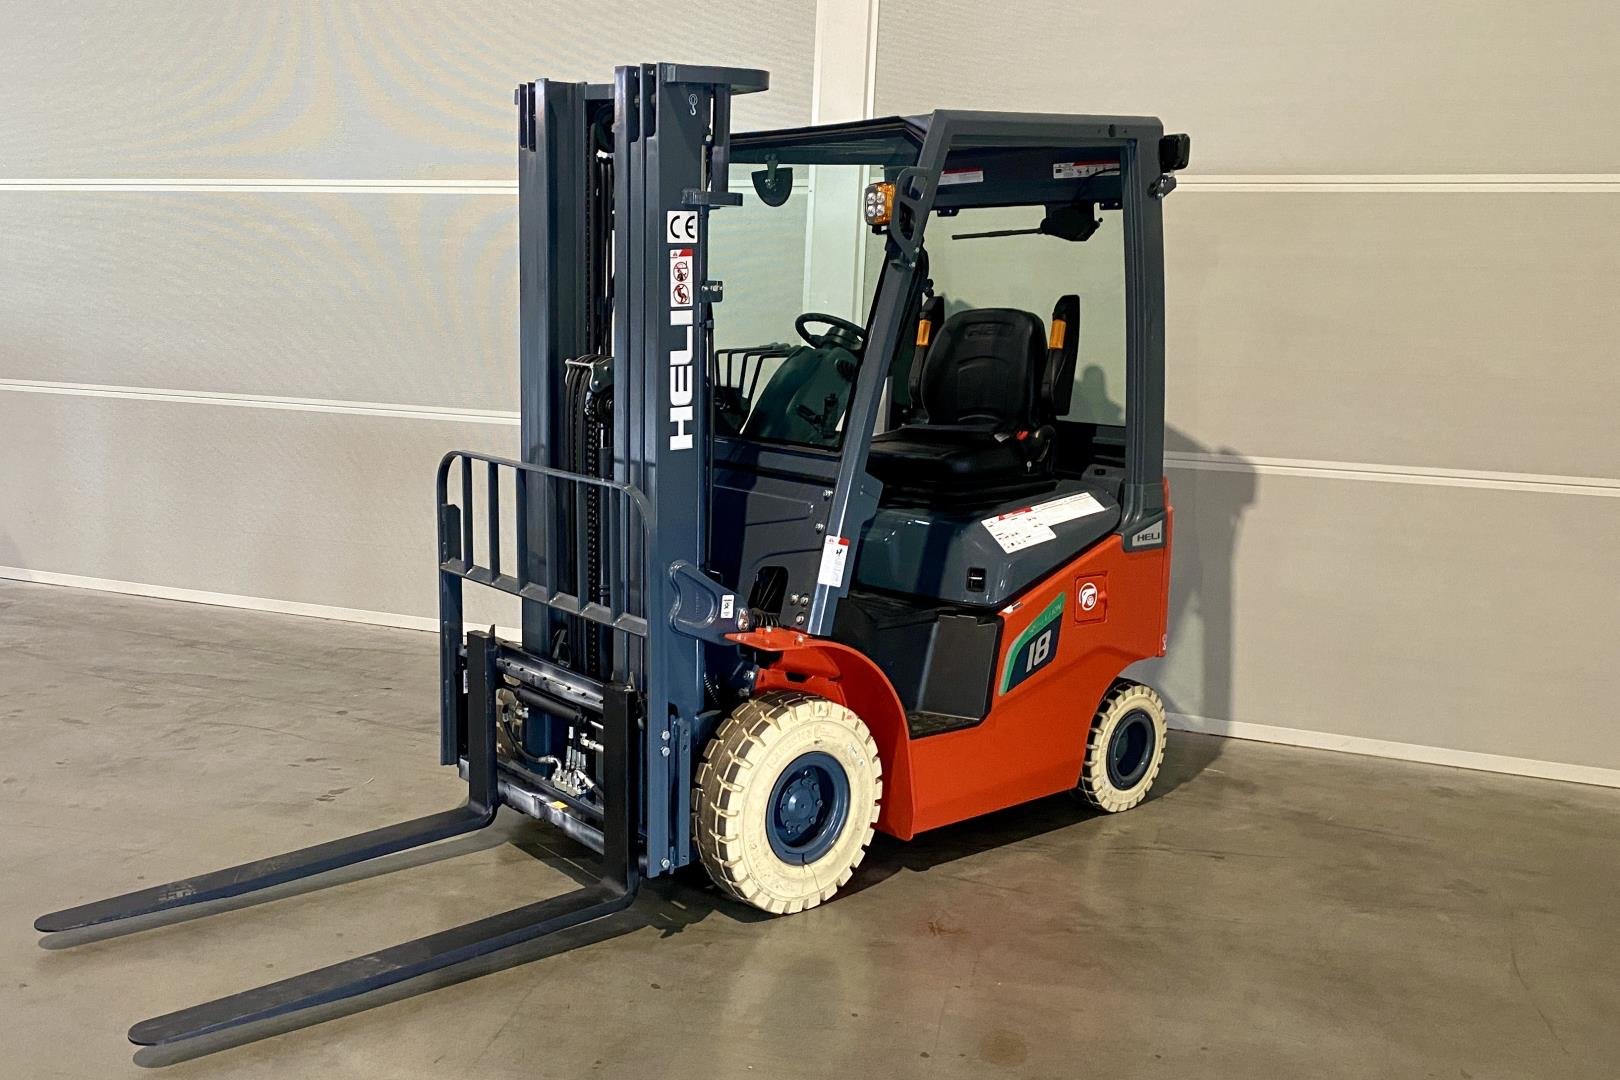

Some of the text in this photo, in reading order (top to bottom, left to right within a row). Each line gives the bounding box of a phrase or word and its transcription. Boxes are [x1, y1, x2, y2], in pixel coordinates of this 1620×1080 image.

[670, 215, 696, 239] CE
[670, 310, 693, 450] HELI
[1137, 532, 1161, 542] HELI
[1025, 629, 1052, 673] 18
